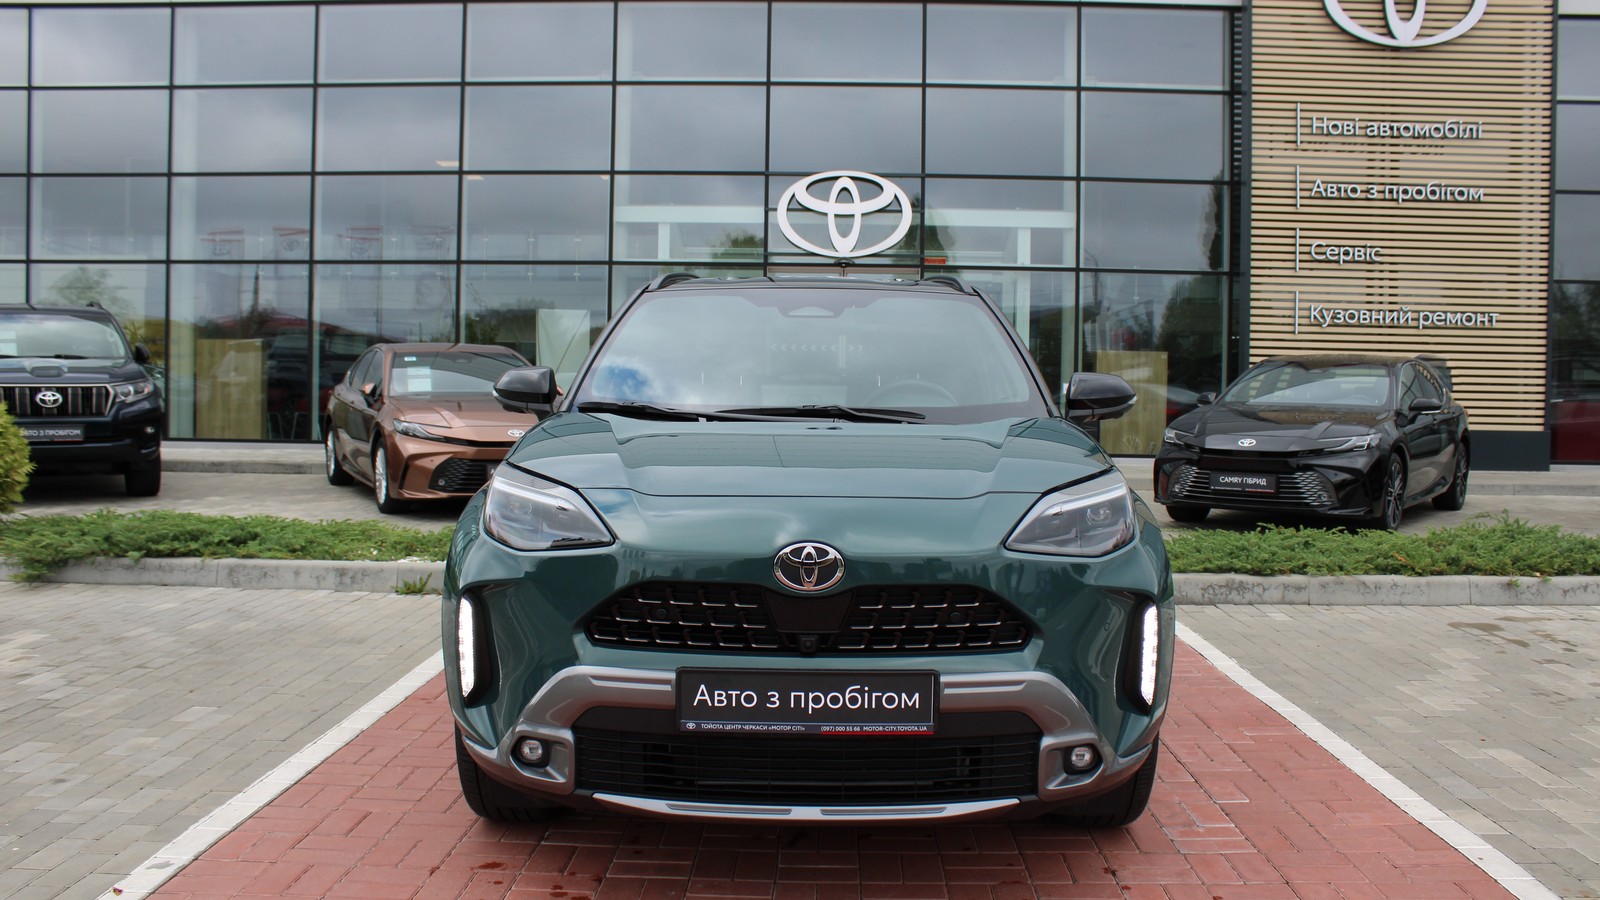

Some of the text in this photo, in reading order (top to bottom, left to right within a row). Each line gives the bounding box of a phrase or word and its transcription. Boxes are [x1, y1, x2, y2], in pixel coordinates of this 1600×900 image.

[1312, 116, 1483, 139] Нові автомобілі
[1311, 179, 1484, 204] Авто з пробігом
[1310, 241, 1383, 265] Сервіс
[1309, 304, 1500, 330] Кузовний ремонт
[1219, 476, 1267, 486] CAMRY ГІБРИД
[693, 684, 920, 714] Авто з пробігом
